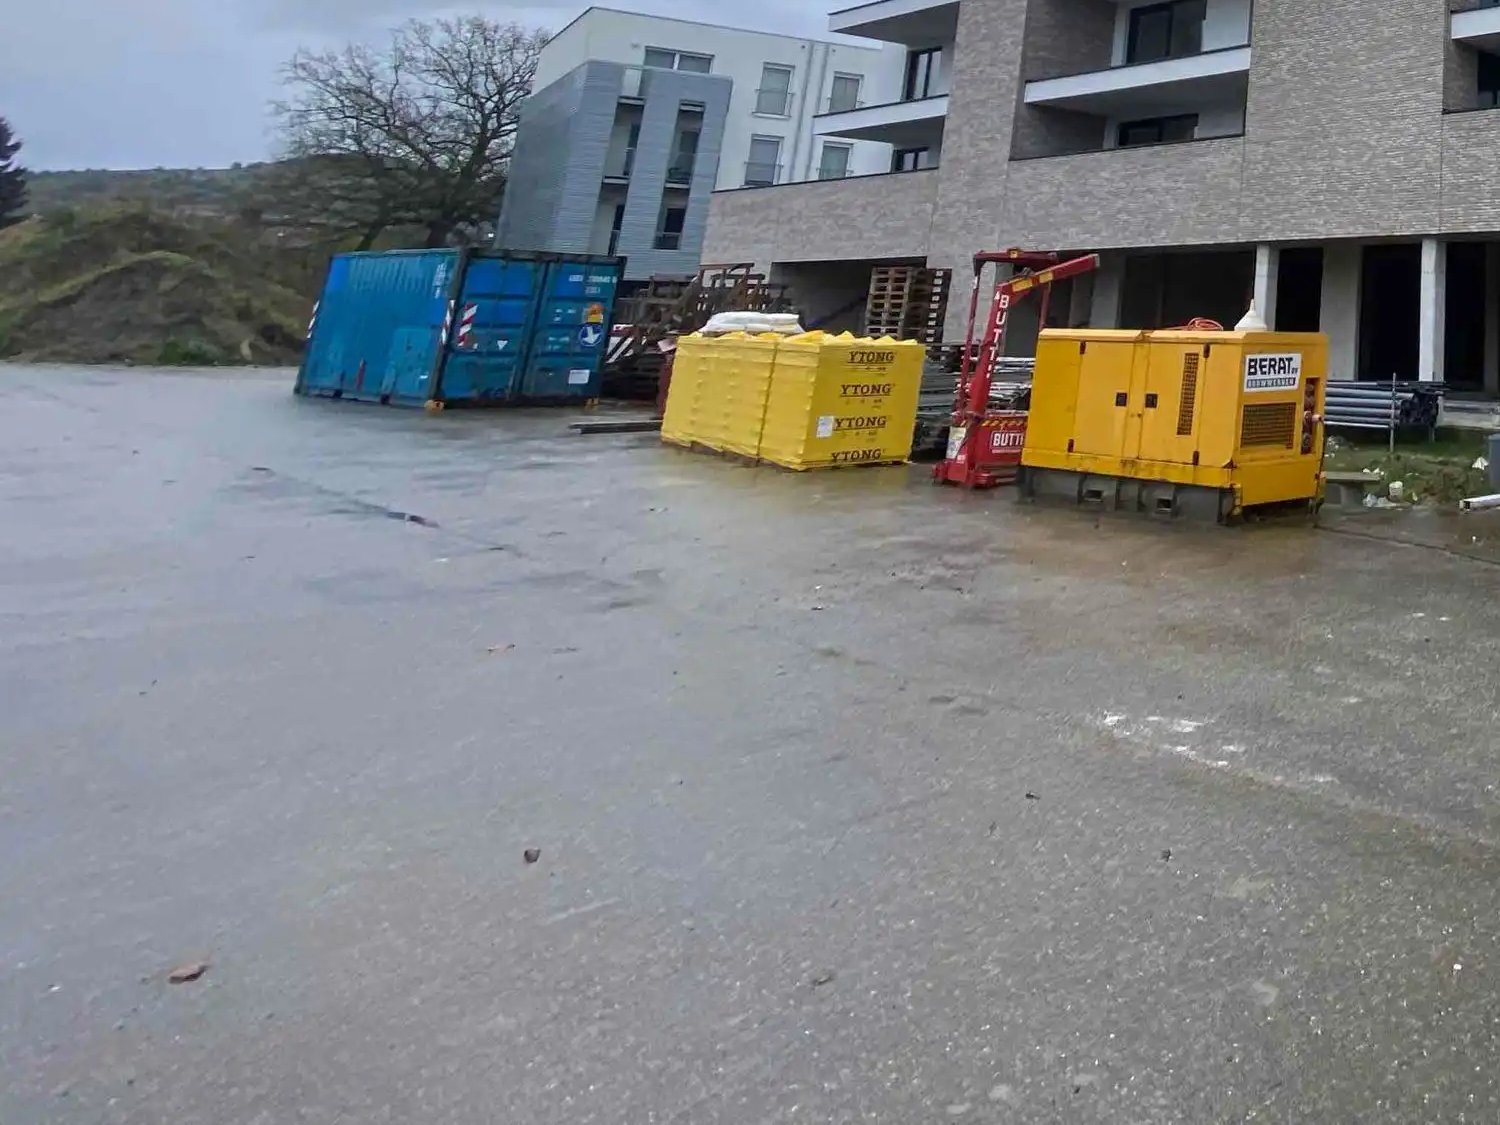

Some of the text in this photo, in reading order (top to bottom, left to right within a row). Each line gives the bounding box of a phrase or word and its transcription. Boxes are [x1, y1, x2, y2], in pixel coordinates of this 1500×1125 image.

[848, 350, 896, 363] YTONG
[1247, 357, 1293, 376] BERAT
[840, 383, 892, 396] YTONG
[834, 416, 887, 428] YTONG
[830, 449, 882, 463] YTONG
